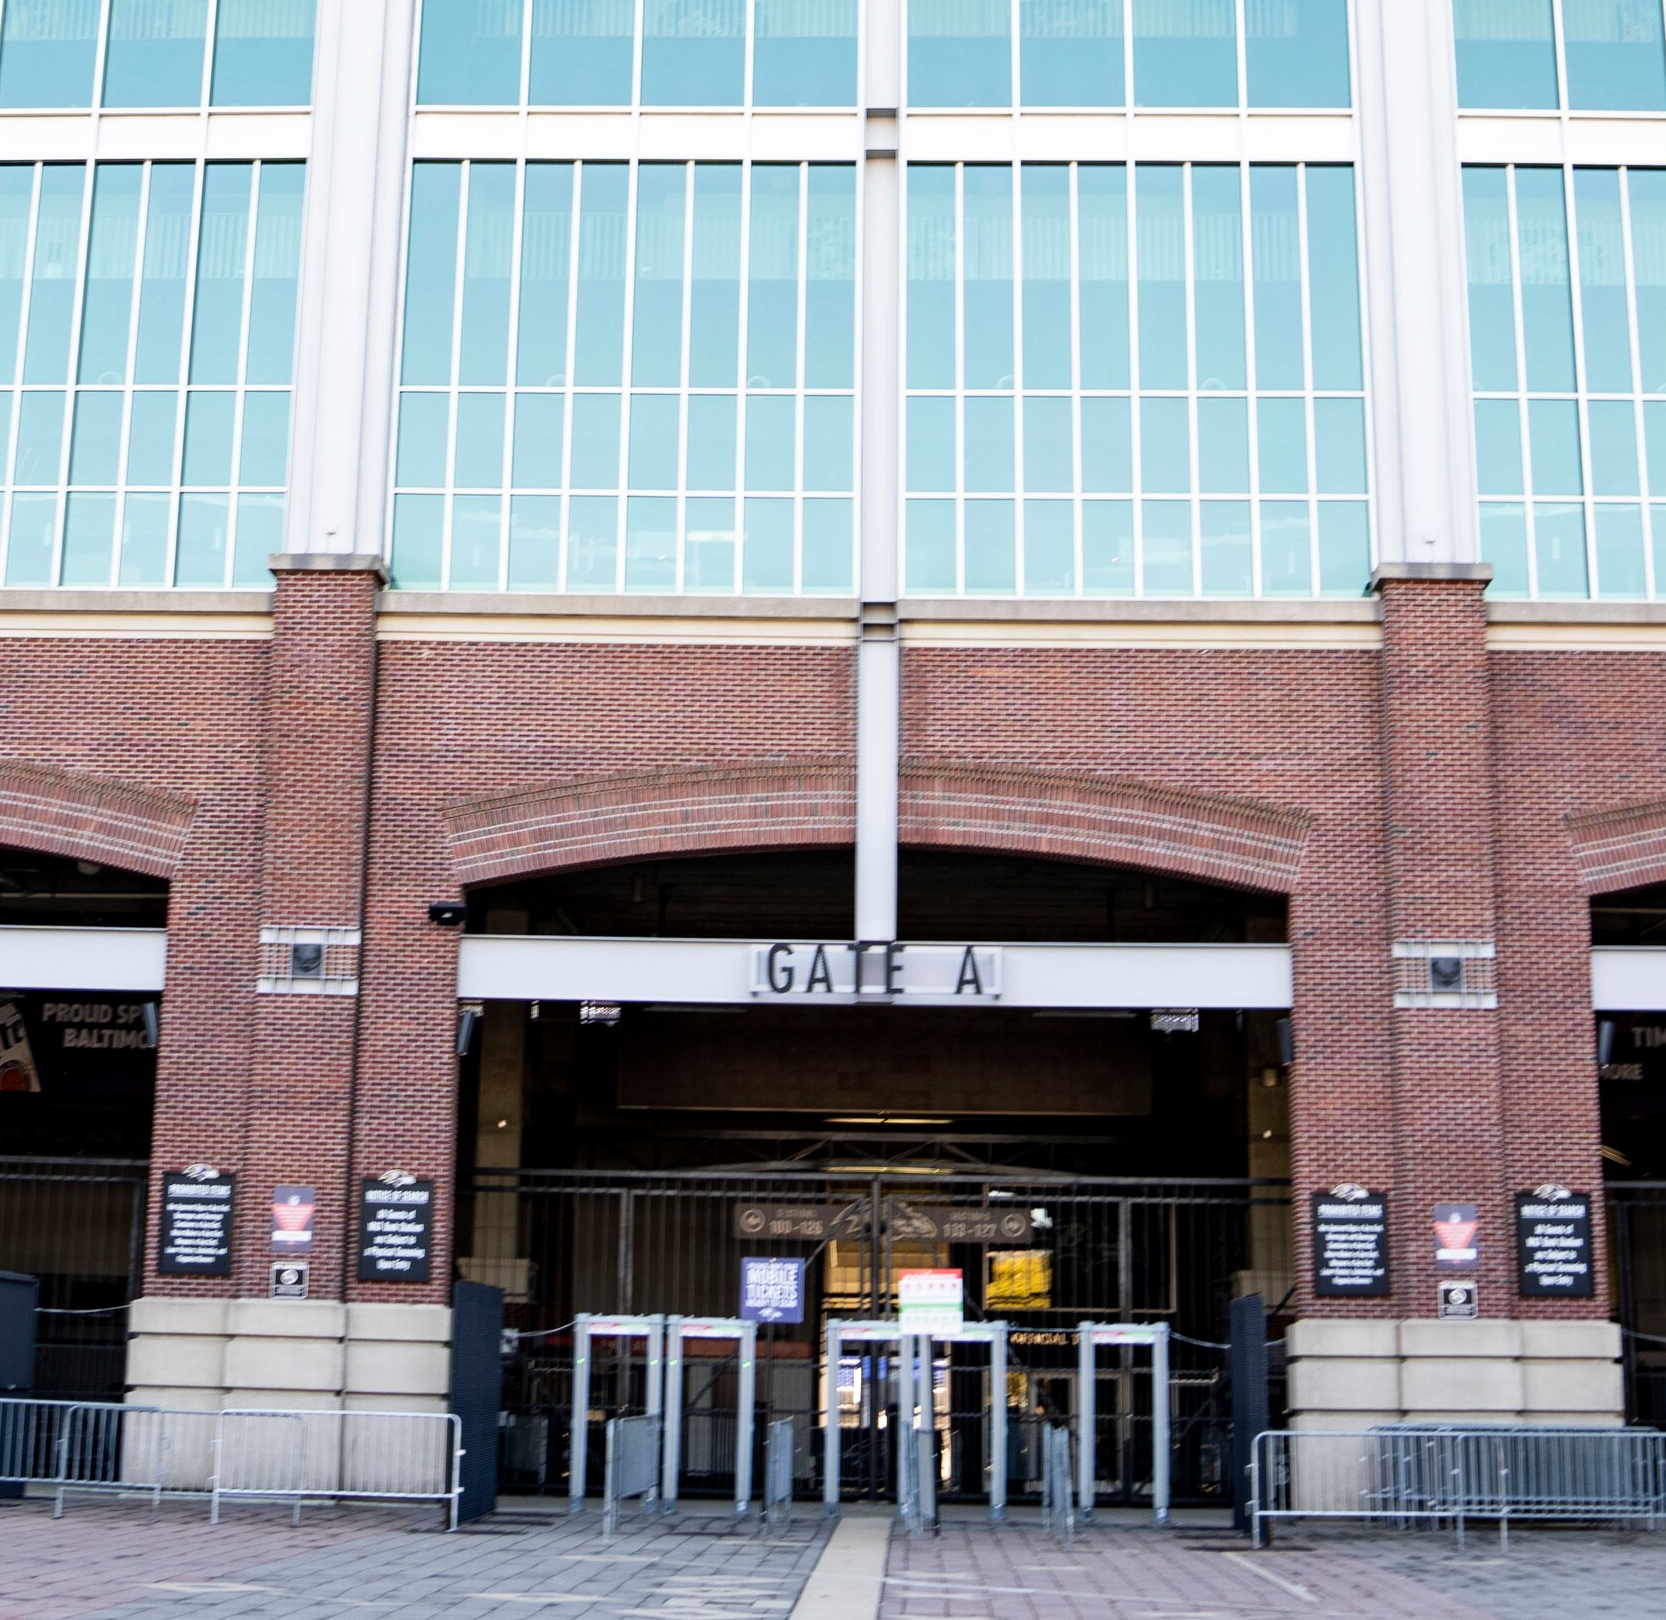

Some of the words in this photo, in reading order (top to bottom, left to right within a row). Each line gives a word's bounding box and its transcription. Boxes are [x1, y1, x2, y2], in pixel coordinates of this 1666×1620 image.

[767, 942, 904, 994] GATE
[955, 945, 982, 995] A
[41, 1001, 114, 1024] PROUD
